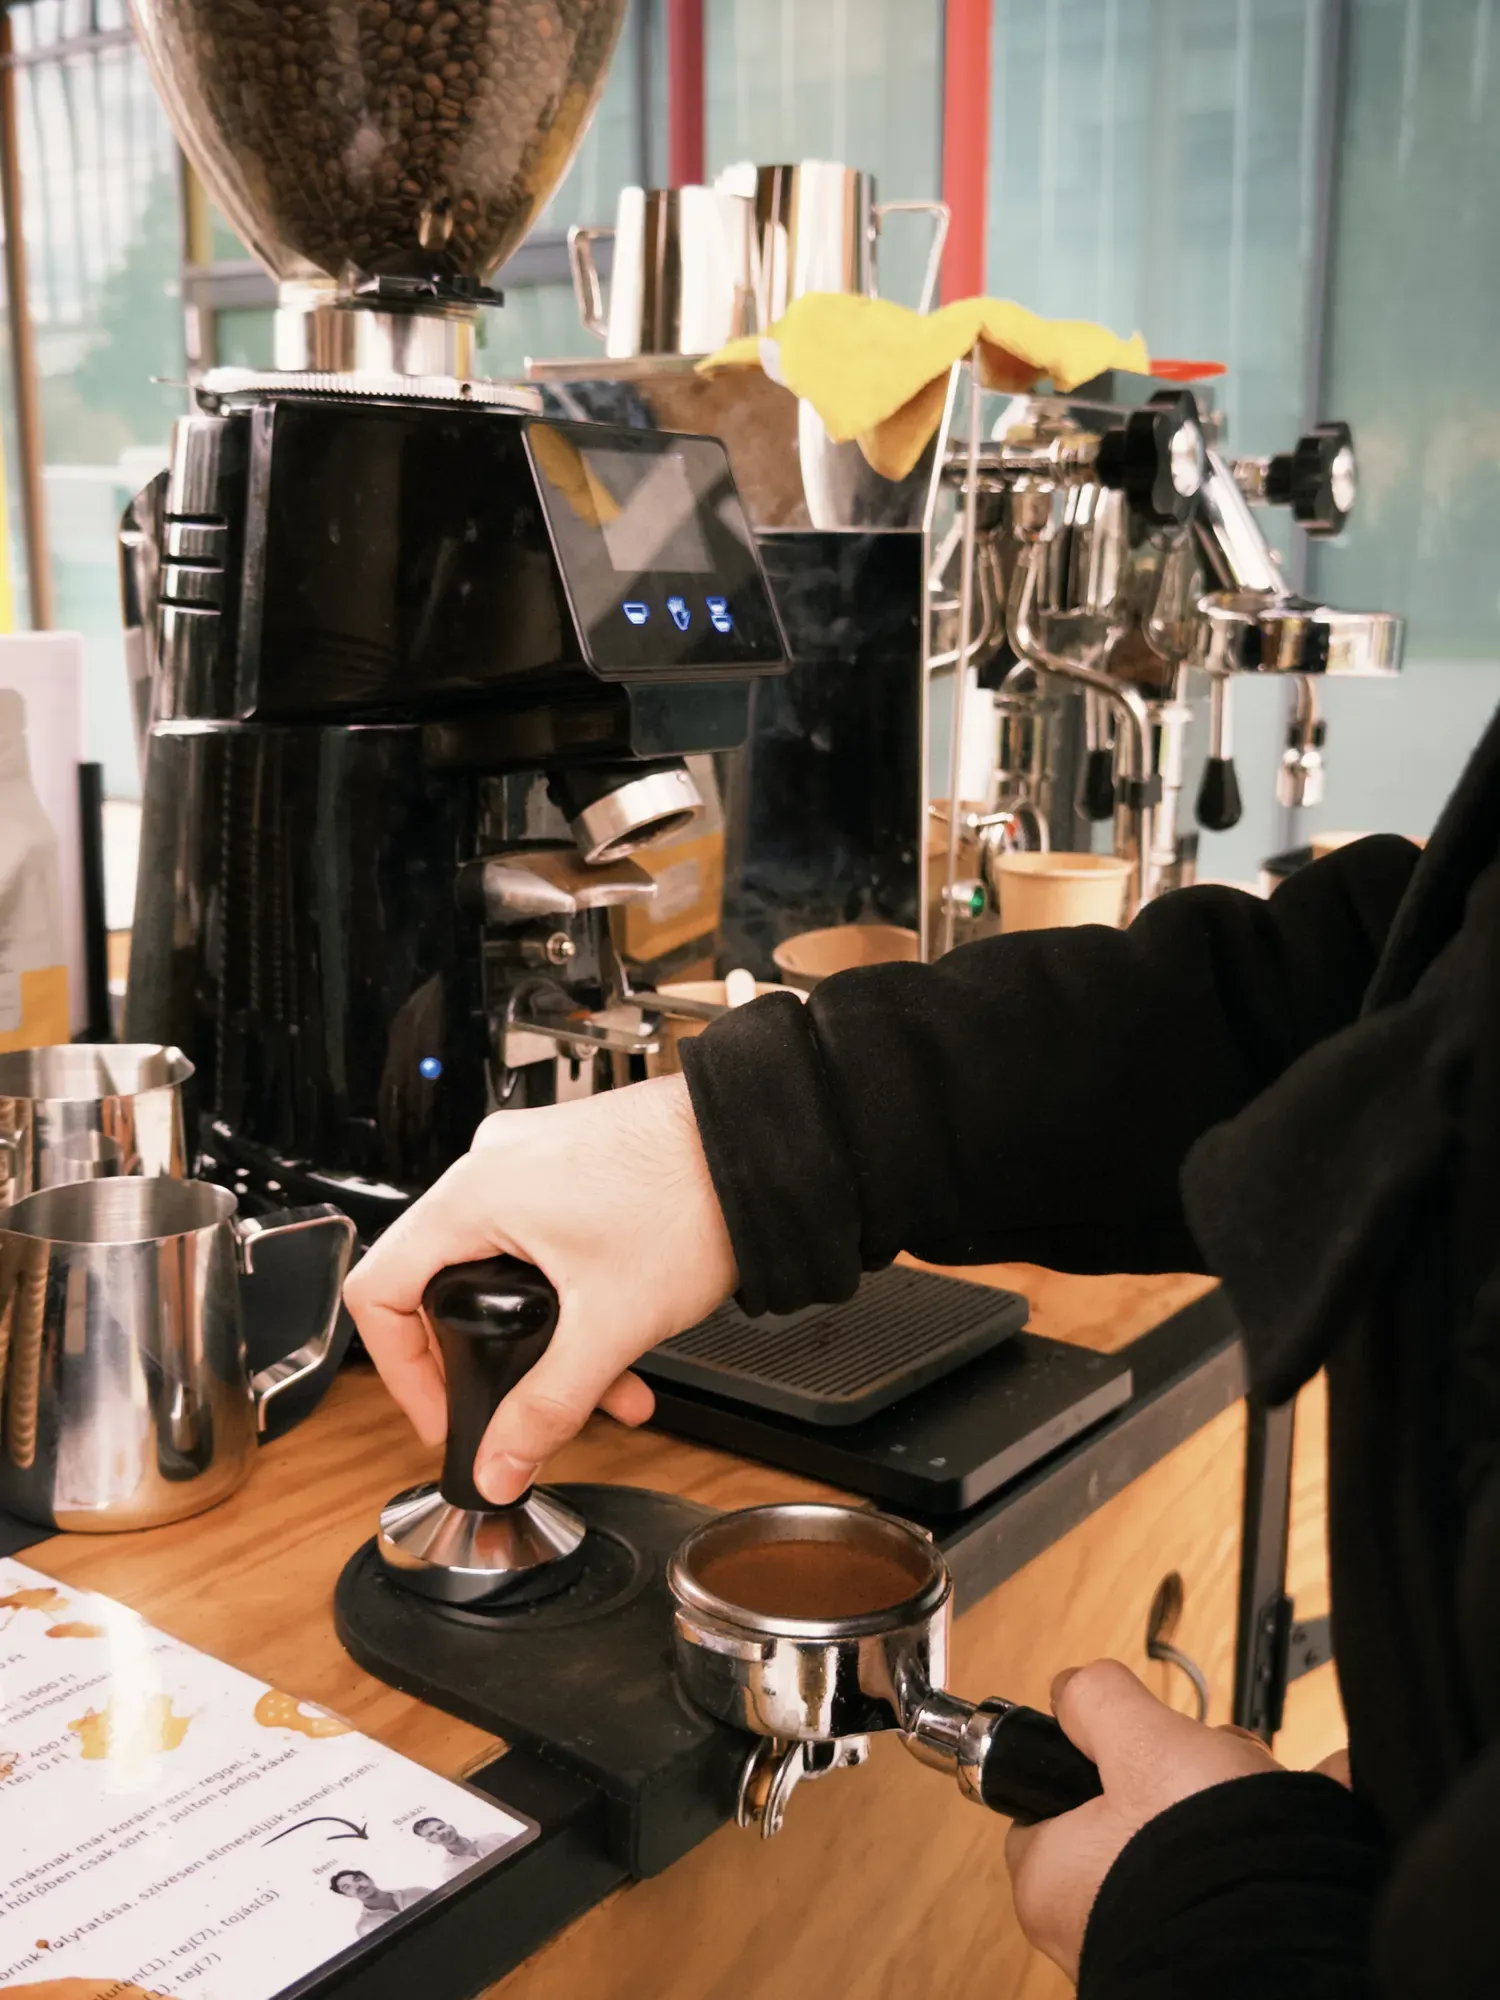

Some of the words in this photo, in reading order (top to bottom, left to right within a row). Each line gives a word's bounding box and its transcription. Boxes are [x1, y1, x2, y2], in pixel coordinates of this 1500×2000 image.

[19, 1681, 60, 1701] 1000
[30, 1740, 60, 1758] 400
[5, 1867, 78, 1911] hűtőben
[79, 1847, 117, 1871] csak
[169, 1792, 219, 1824] pulton
[219, 1768, 262, 1796] pedig
[257, 1748, 299, 1773] kávét
[9, 1851, 74, 1889] másnak
[75, 1833, 108, 1853] már
[138, 1859, 206, 1901] szívesen
[219, 1888, 280, 1928] tojás(3)
[174, 1951, 222, 1984] tej(7)
